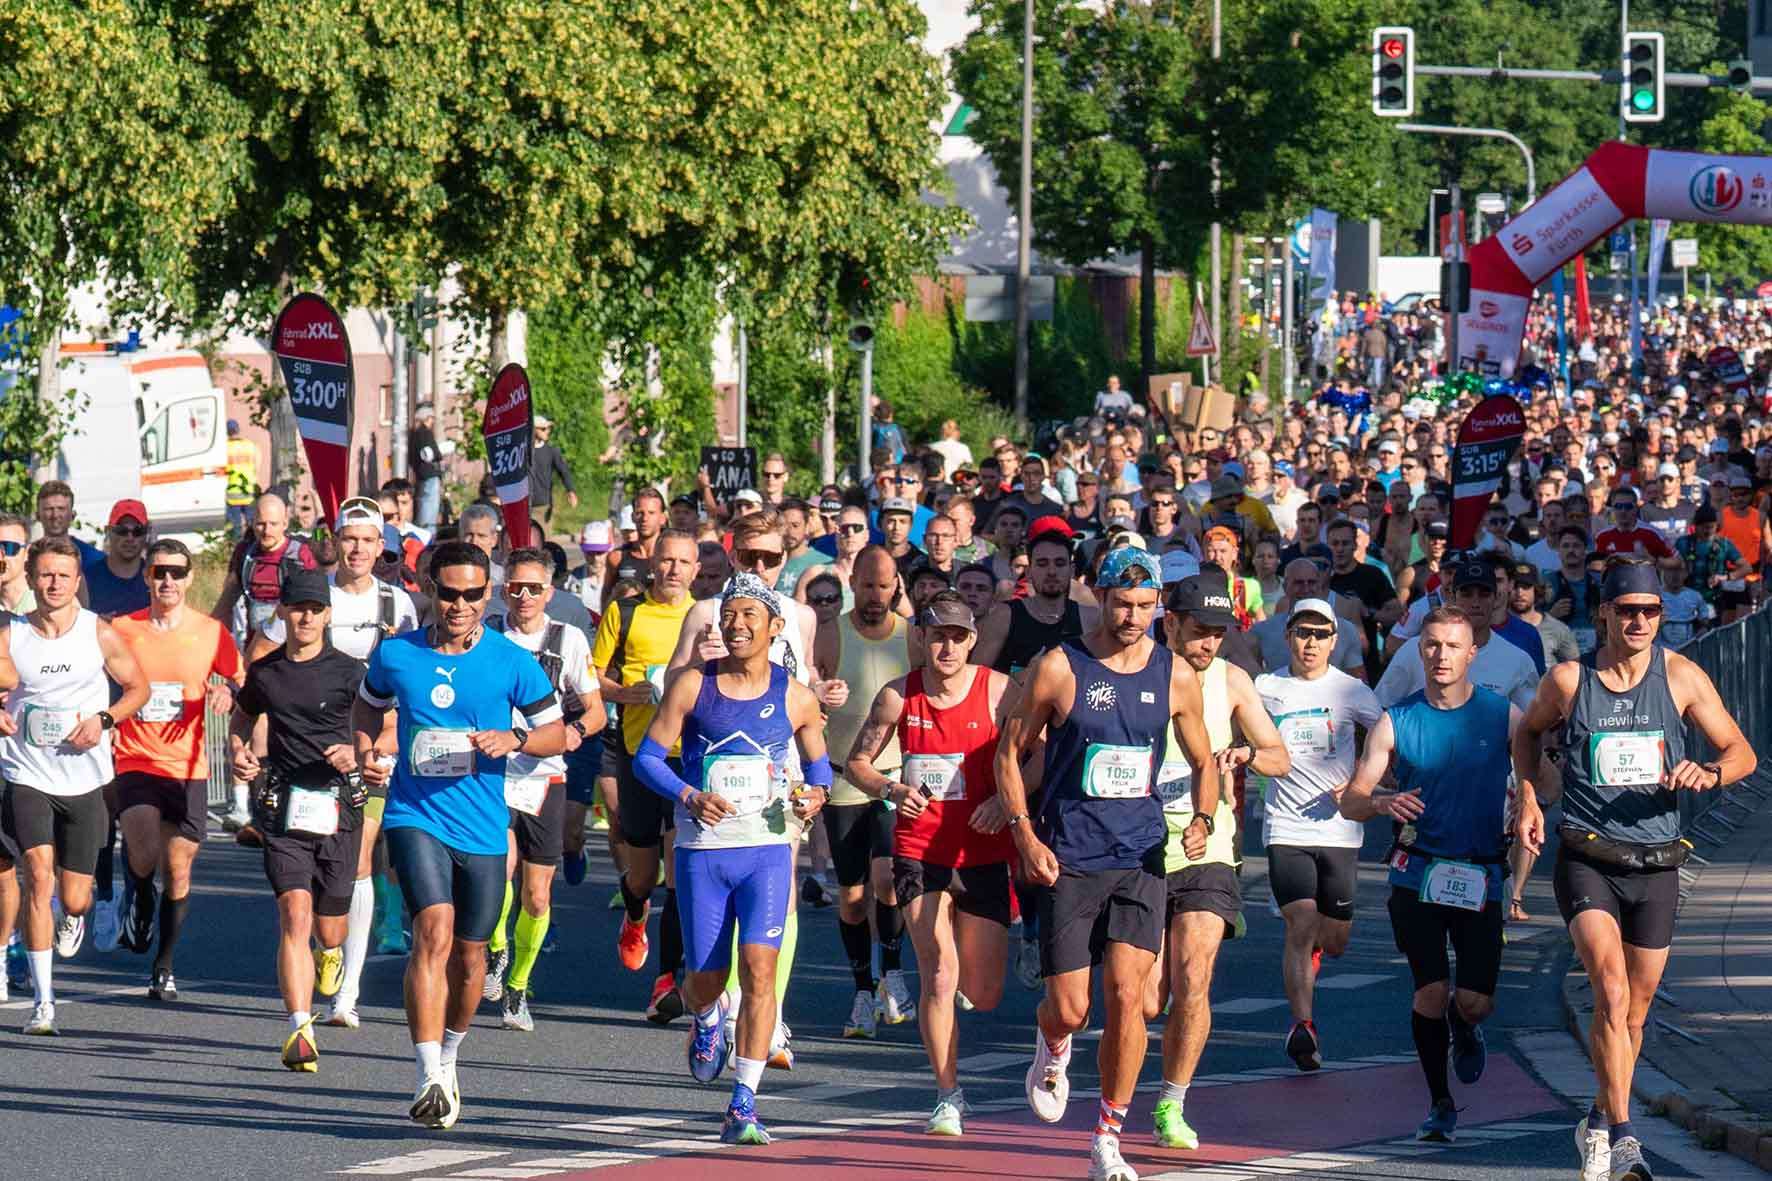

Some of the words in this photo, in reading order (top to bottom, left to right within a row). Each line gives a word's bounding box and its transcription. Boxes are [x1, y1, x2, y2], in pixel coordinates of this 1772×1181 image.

[308, 322, 339, 339] XXL
[293, 362, 313, 375] SUB
[496, 434, 512, 448] SUB
[1204, 596, 1231, 609] HOKA
[40, 663, 72, 678] RUN
[42, 722, 62, 733] 245
[1598, 715, 1650, 728] newline
[1294, 730, 1313, 741] 246
[1618, 753, 1635, 766] 57
[920, 773, 943, 785] 308
[1105, 766, 1137, 780] 1053
[1161, 782, 1185, 793] 784
[1445, 879, 1468, 892] 183
